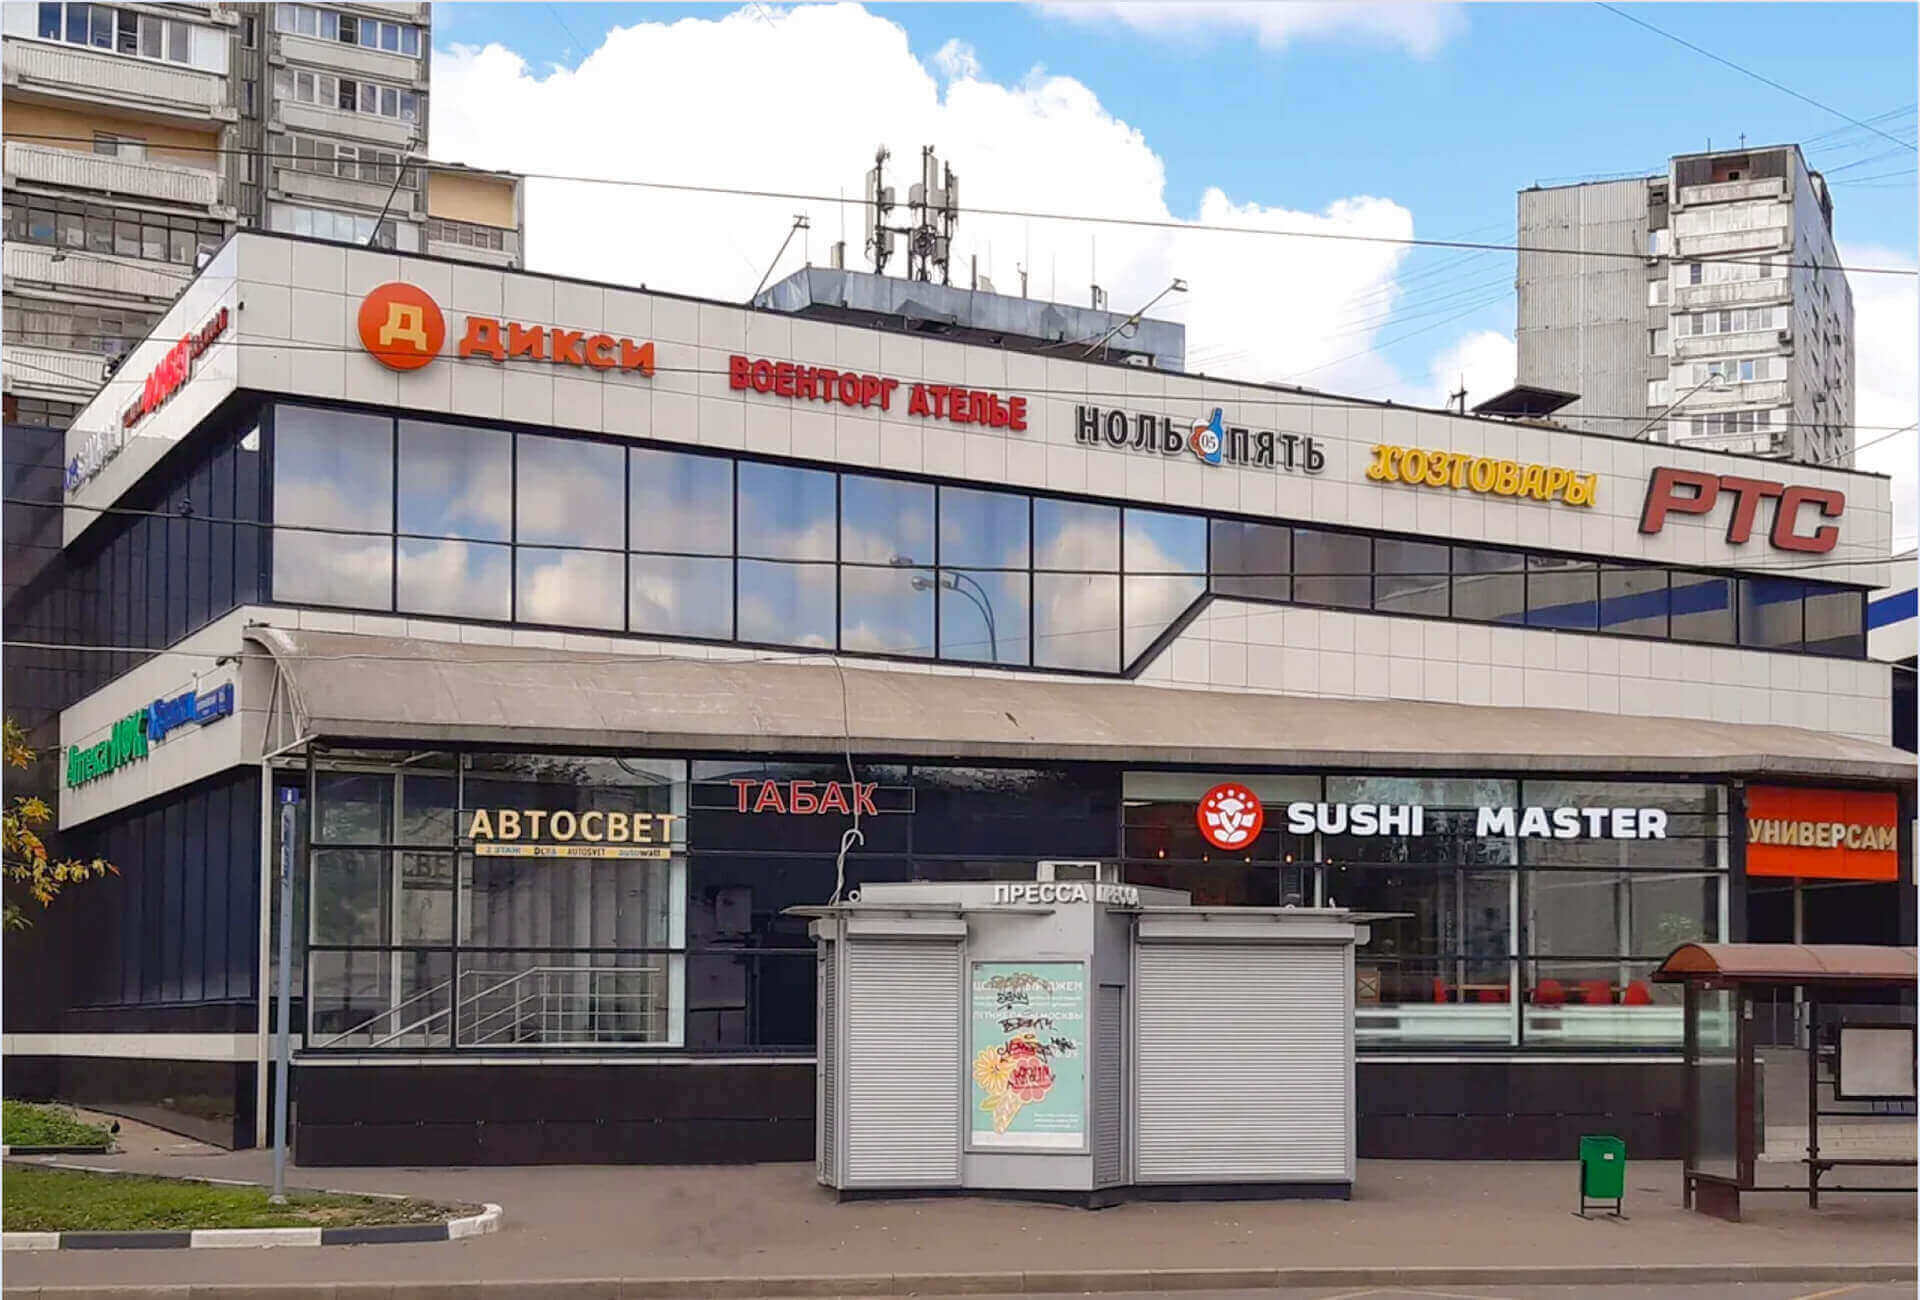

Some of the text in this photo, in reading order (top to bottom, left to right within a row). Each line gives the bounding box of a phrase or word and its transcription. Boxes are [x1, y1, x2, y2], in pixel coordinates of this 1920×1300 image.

[377, 303, 429, 352] Д
[459, 316, 656, 377] ДИКСИ
[728, 355, 1028, 432] ВОЕНТОРГ АТЕЛЬЕ
[1076, 403, 1328, 474] НОЛЬ ПЯТЬ
[1365, 443, 1600, 508] ХОЗТОВАРЫ
[1638, 466, 1847, 555] РТС
[729, 778, 879, 816] ТАБАК
[1286, 801, 1670, 840] SUSHI MASTER
[467, 808, 679, 843] АВТОСВЕТ
[1748, 817, 1898, 851] УНИВЕРСАМ
[993, 883, 1089, 904] ПРЕССА
